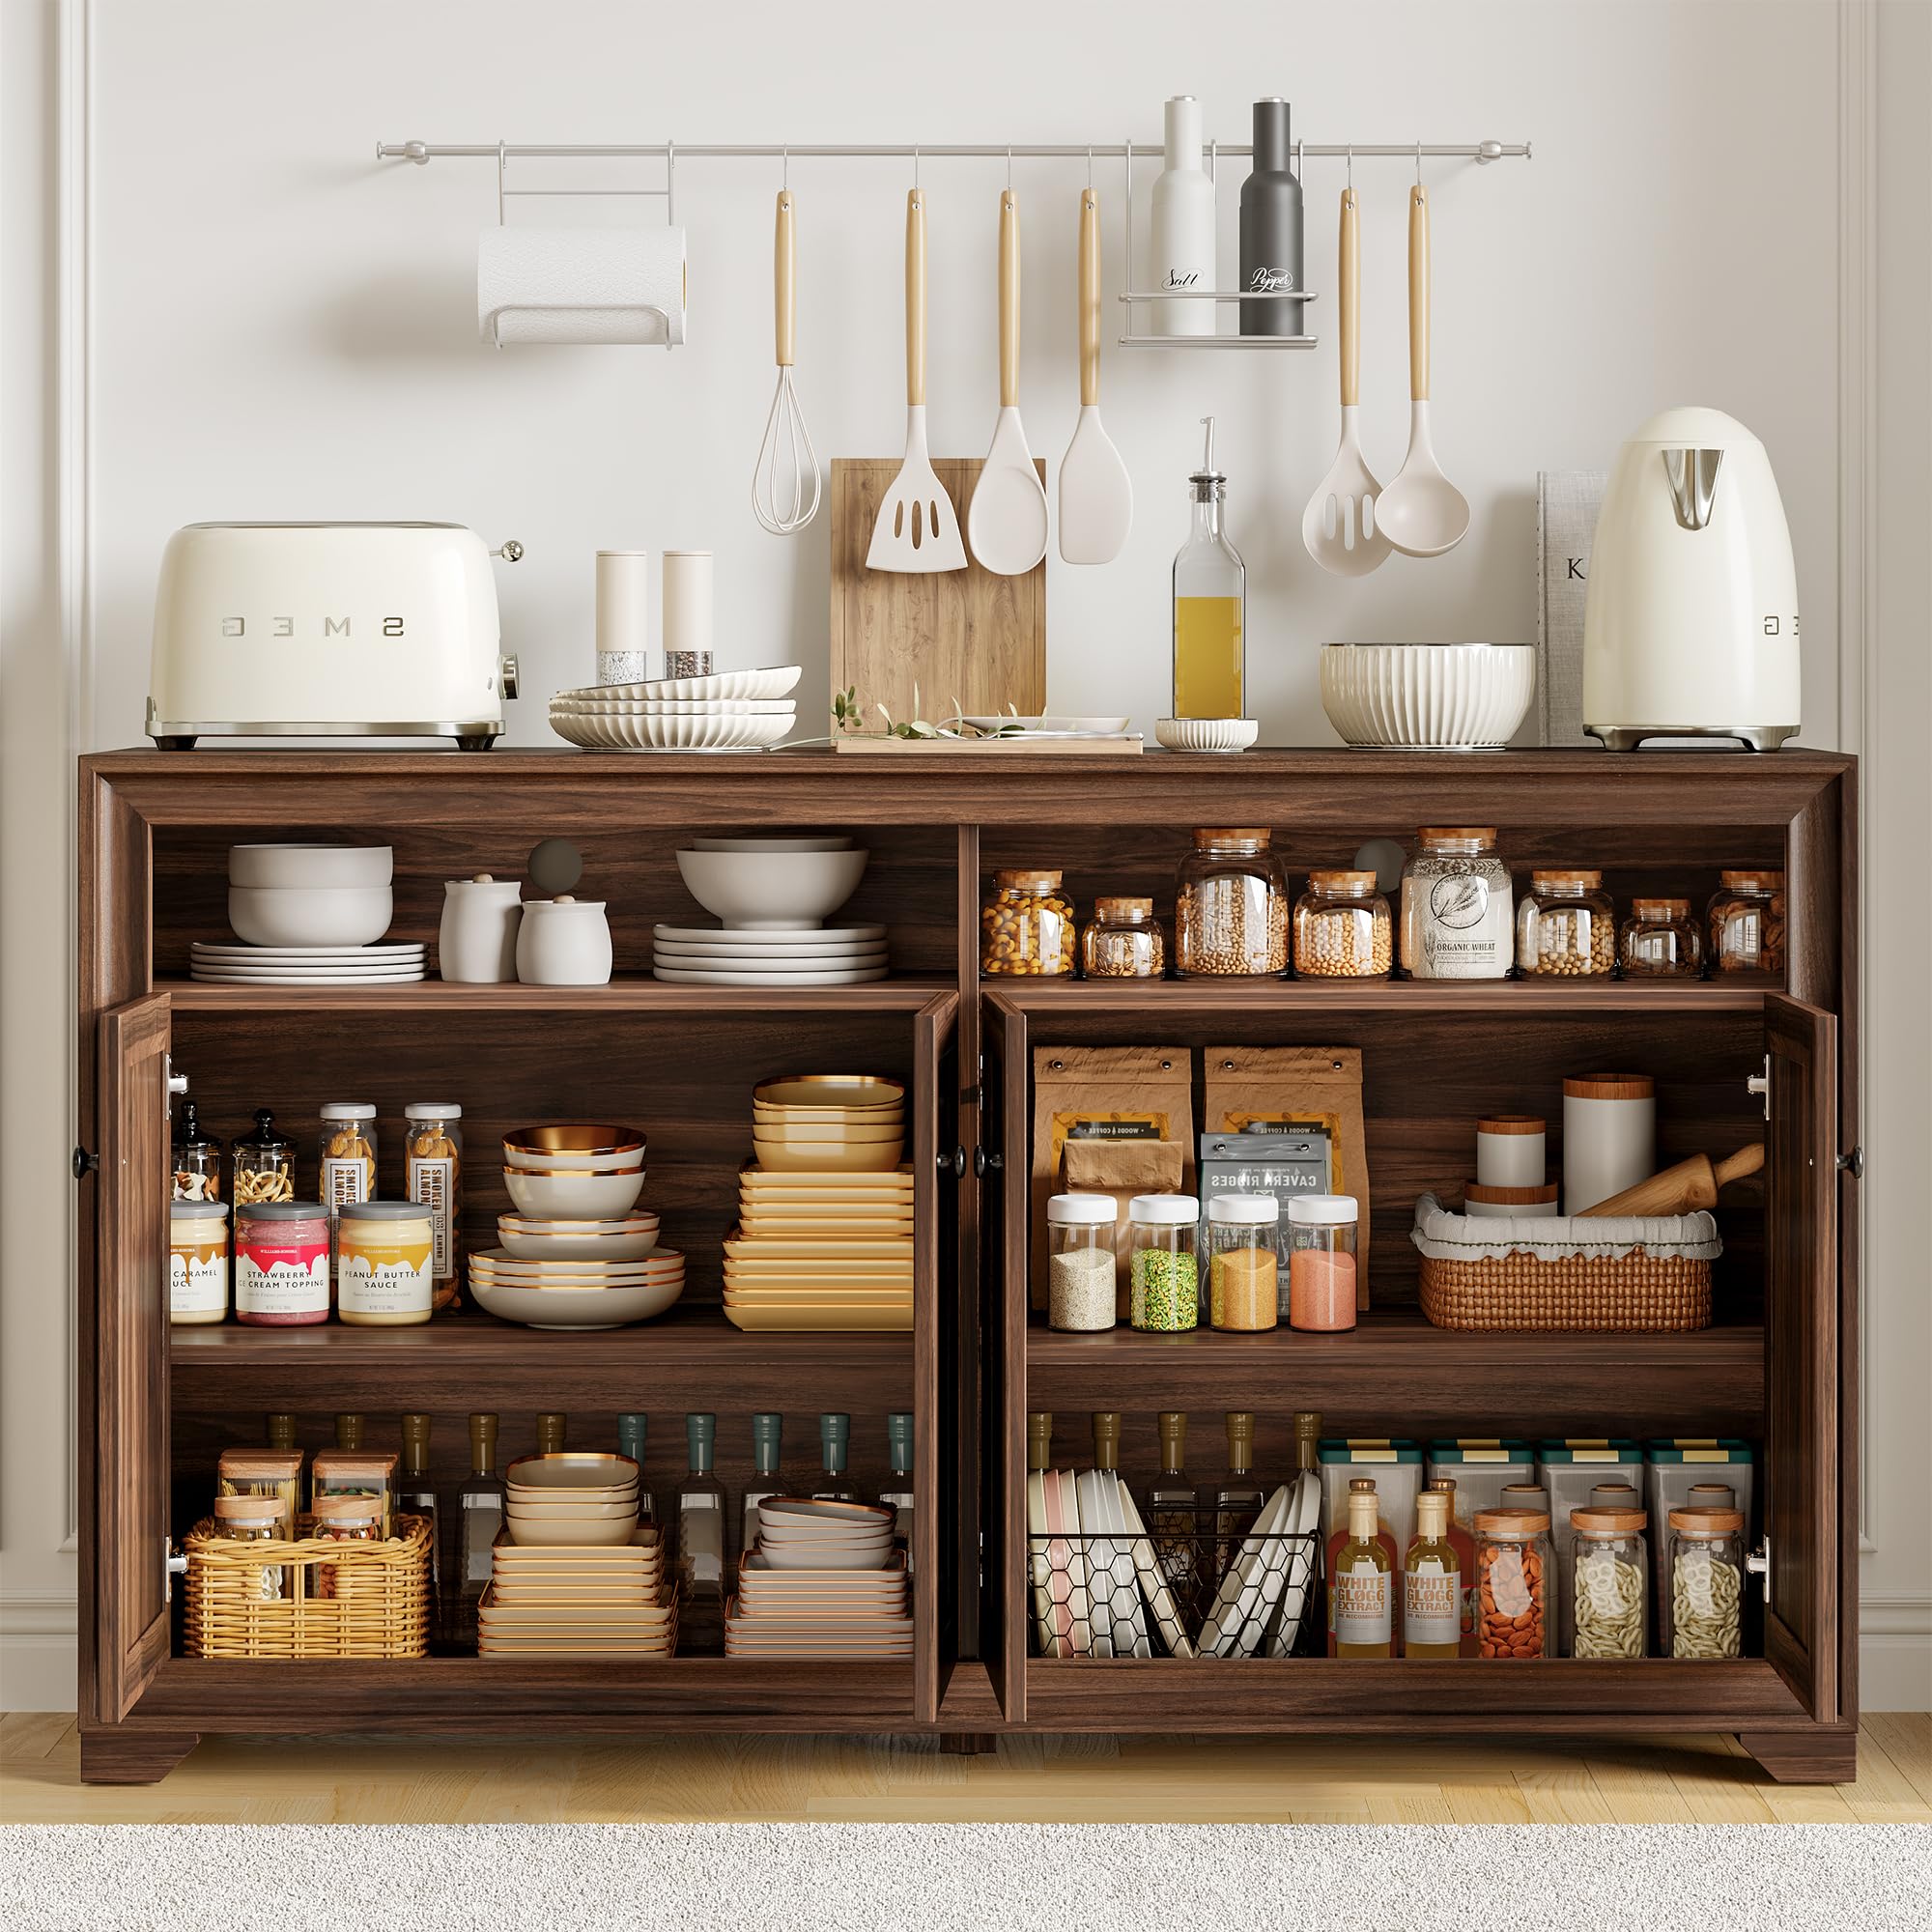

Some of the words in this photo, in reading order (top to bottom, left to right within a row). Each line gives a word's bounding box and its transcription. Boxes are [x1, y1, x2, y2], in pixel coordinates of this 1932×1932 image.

[1250, 268, 1293, 293] Pepper
[1436, 943, 1470, 952] ORGANIC
[1471, 943, 1495, 952] WHEAT
[346, 1169, 356, 1205] SMOKE
[420, 1169, 431, 1206] ALMON
[432, 1169, 442, 1210] SMOKED
[285, 1280, 324, 1289] TOPPING
[1337, 1576, 1384, 1589] WHITE
[1406, 1576, 1454, 1589] WHITE
[1338, 1602, 1384, 1611] EXTRACT
[1406, 1602, 1454, 1611] EXTRACT
